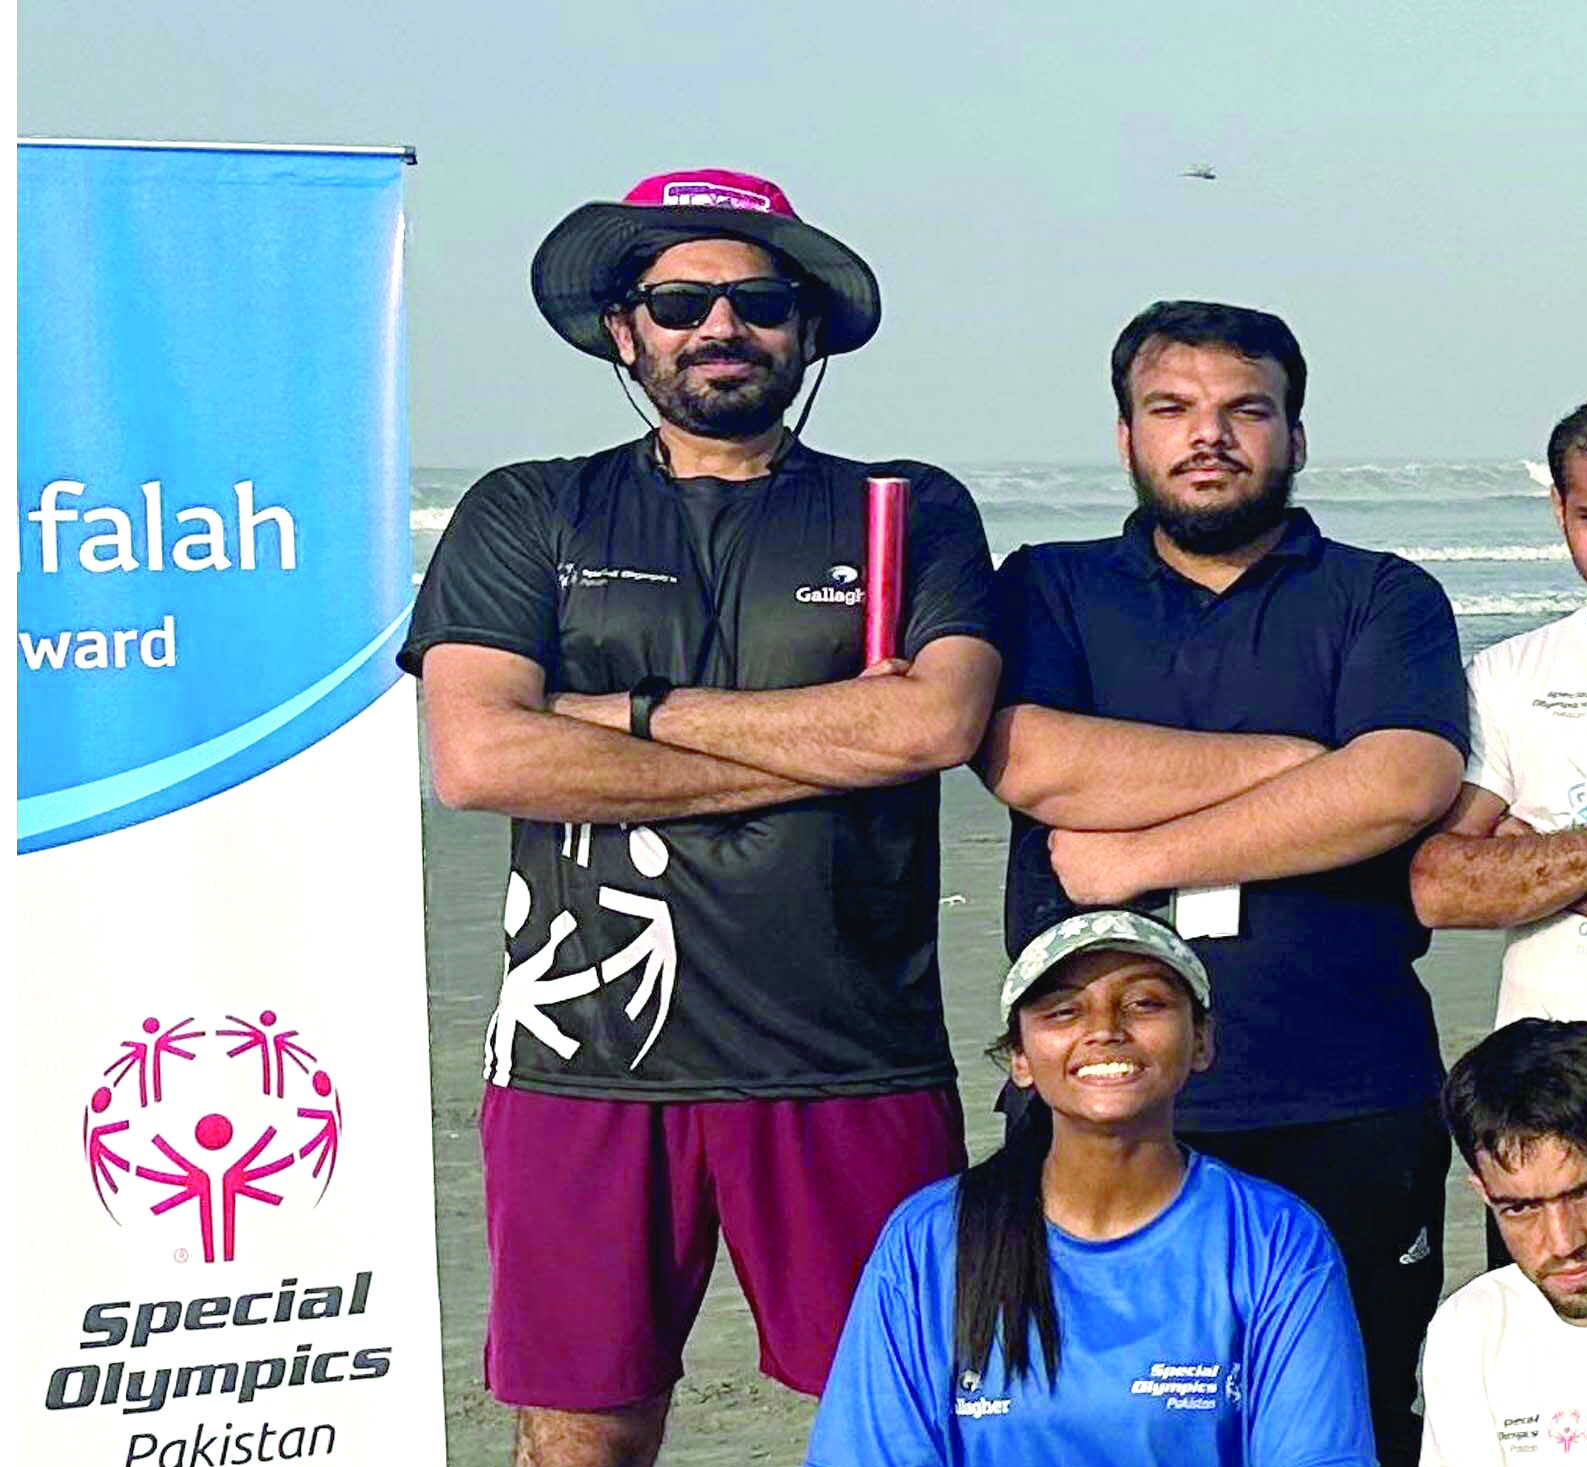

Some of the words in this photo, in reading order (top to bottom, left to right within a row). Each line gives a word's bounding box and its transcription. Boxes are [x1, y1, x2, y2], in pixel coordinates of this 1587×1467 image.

[17, 478, 298, 574] falah
[80, 1271, 372, 1350] Special
[44, 1343, 393, 1415] Olympics
[1131, 1389, 1219, 1407] Olympics
[1150, 1373, 1220, 1389] Special
